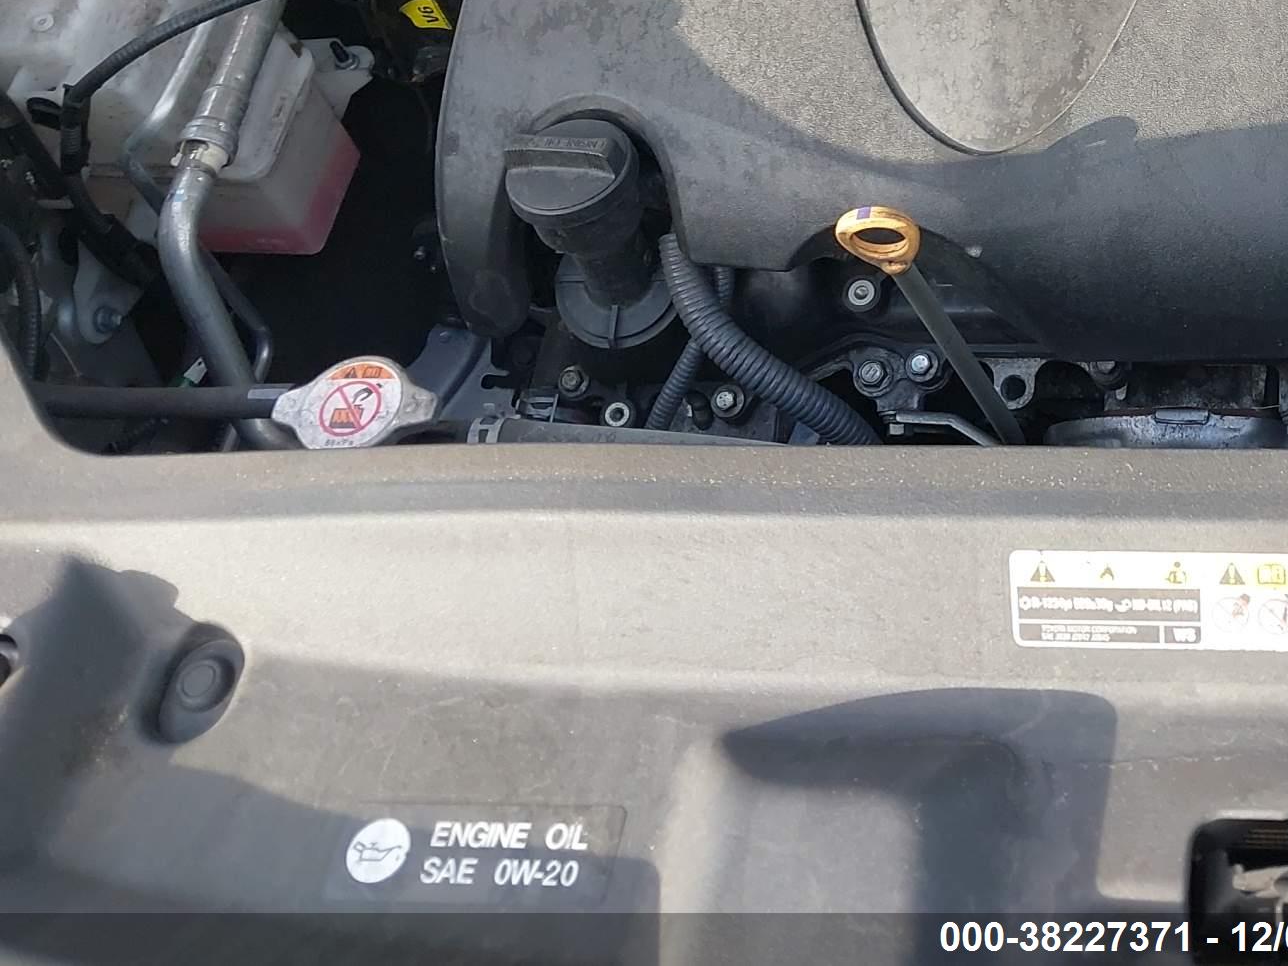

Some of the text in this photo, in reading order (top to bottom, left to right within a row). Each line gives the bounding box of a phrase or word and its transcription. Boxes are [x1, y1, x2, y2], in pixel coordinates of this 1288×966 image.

[418, 6, 440, 23] V6
[430, 821, 588, 850] ENGINE OIL
[419, 856, 579, 887] SAE 0W-20
